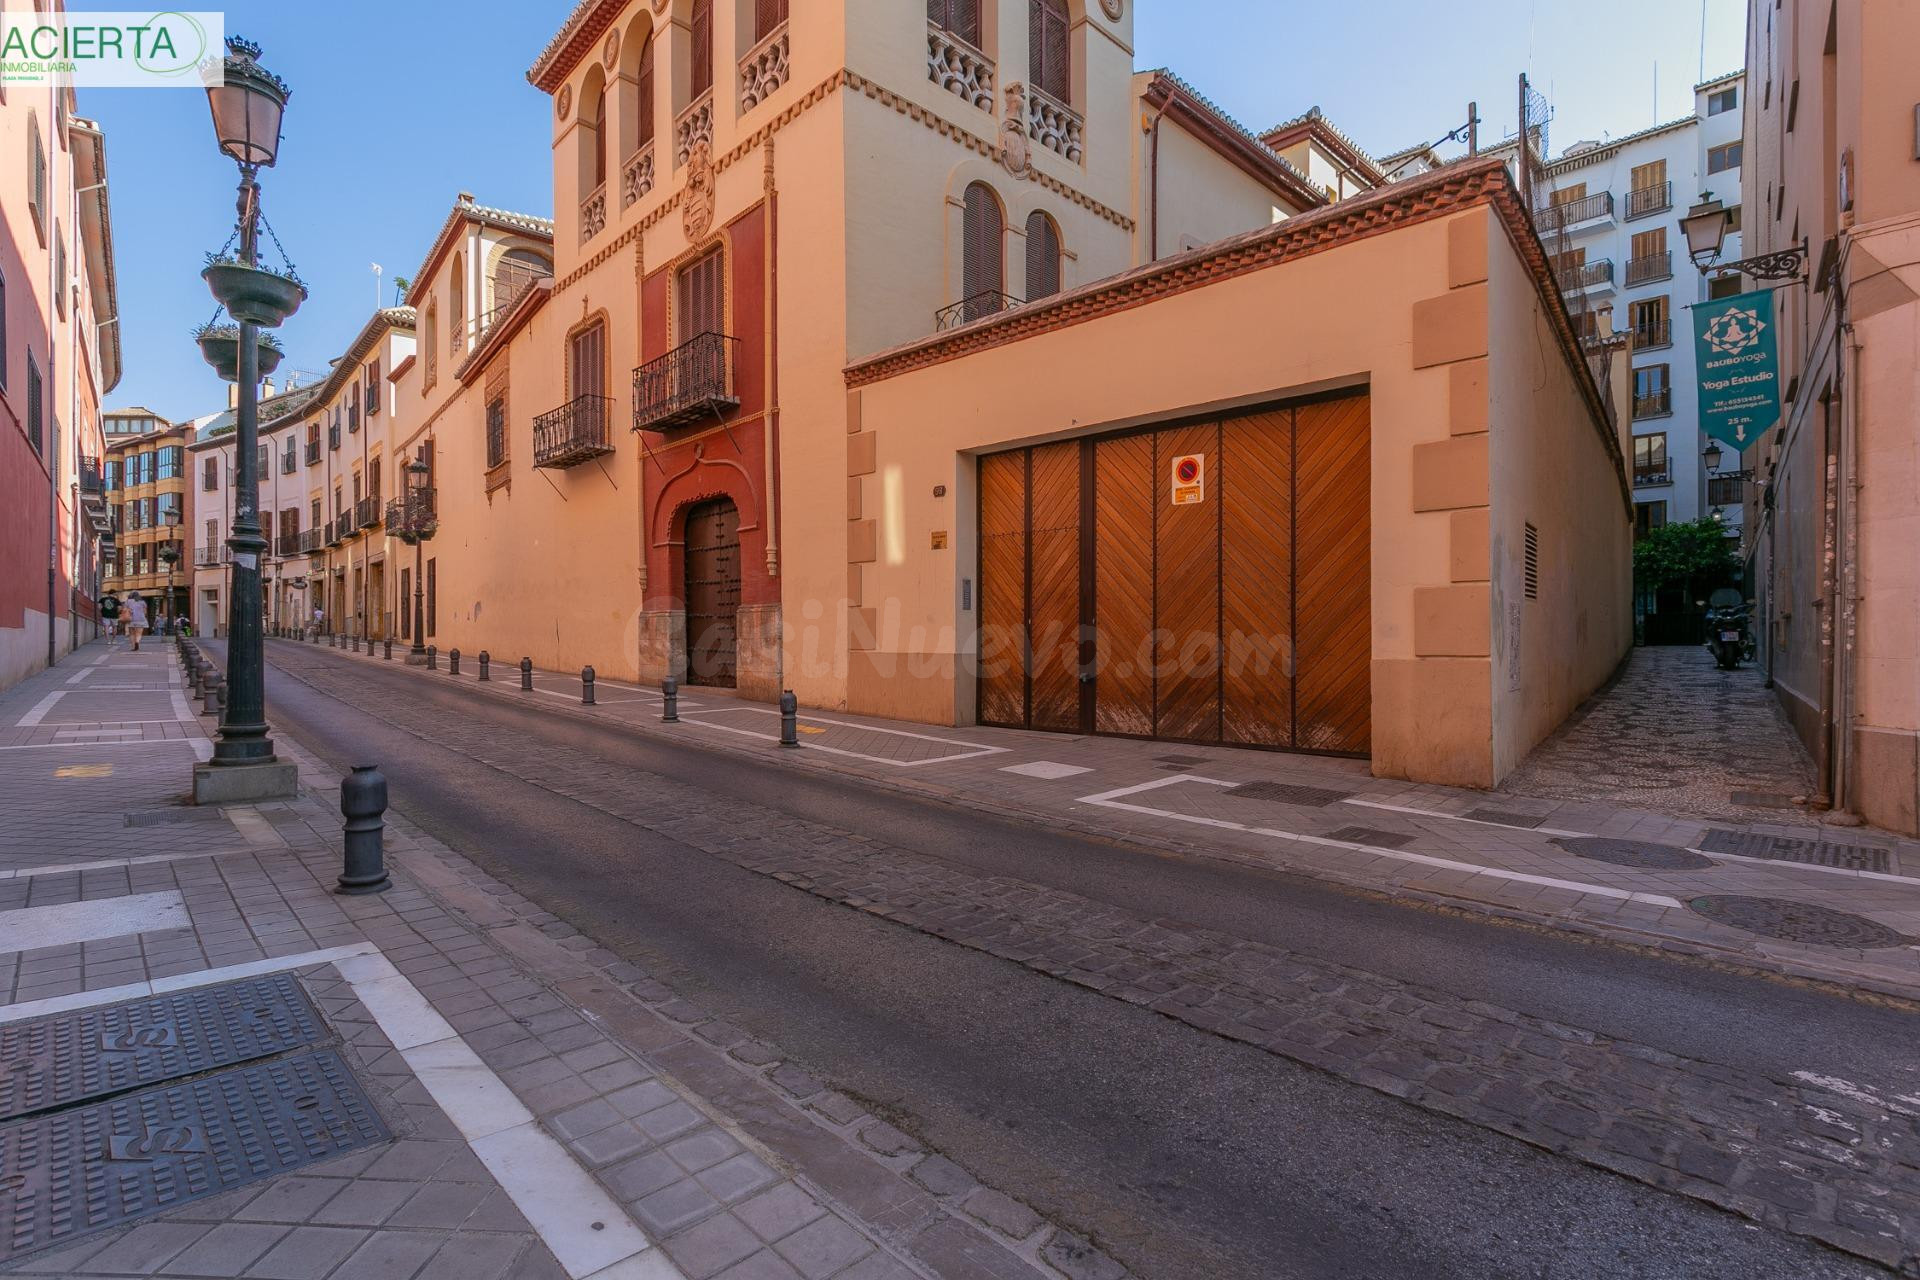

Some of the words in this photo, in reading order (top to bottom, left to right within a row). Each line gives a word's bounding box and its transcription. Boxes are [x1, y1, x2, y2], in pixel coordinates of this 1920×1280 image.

[1702, 380, 1730, 390] Yoga
[1731, 371, 1774, 386] Estudio
[1727, 417, 1739, 425] 25
